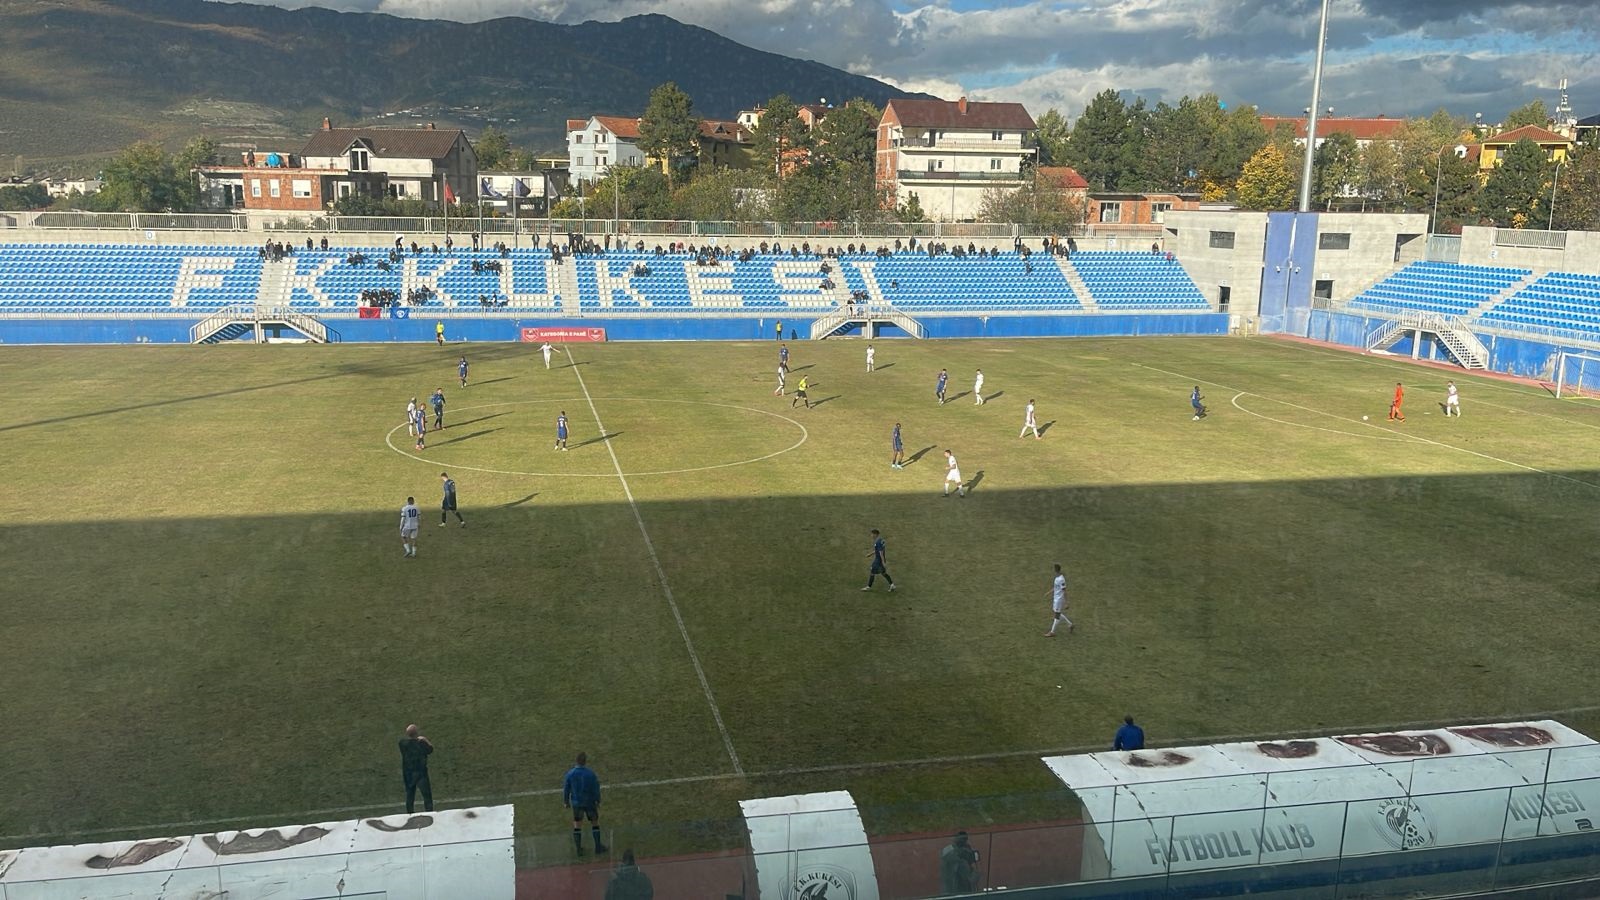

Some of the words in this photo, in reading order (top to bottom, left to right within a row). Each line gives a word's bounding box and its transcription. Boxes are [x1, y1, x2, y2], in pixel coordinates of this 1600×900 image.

[400, 259, 892, 307] KUKESI
[407, 508, 417, 518] 10
[1144, 829, 1252, 865] FUTBOLL
[1250, 823, 1316, 853] KLUB
[1406, 835, 1425, 848] 930
